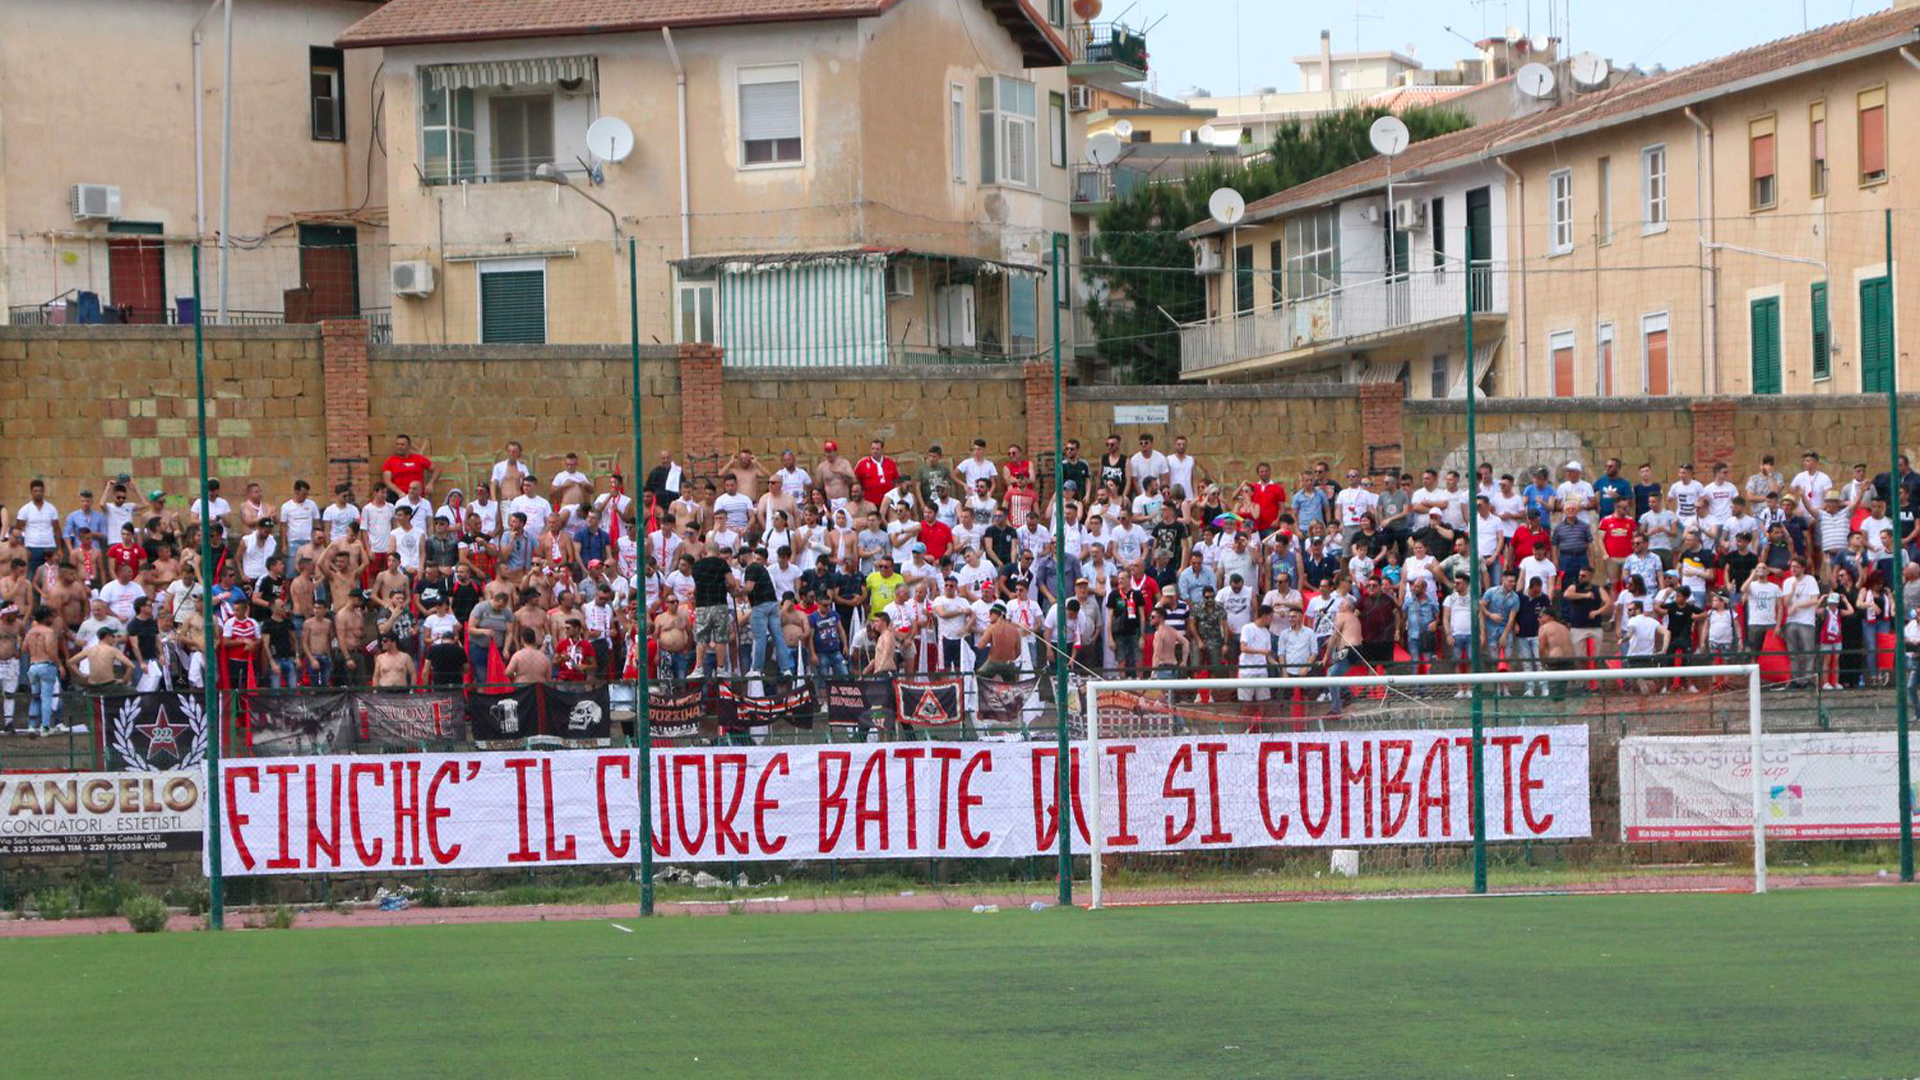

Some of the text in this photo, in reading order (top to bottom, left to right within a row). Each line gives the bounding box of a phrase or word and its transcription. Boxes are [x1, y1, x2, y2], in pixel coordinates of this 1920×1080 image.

[151, 727, 173, 743] 22
[225, 735, 1554, 871] FINCHE' IL CUORE BATTE QUI SI COMBATTE
[2, 818, 102, 834] CONCIATORI
[117, 816, 181, 831] ESTETISTI
